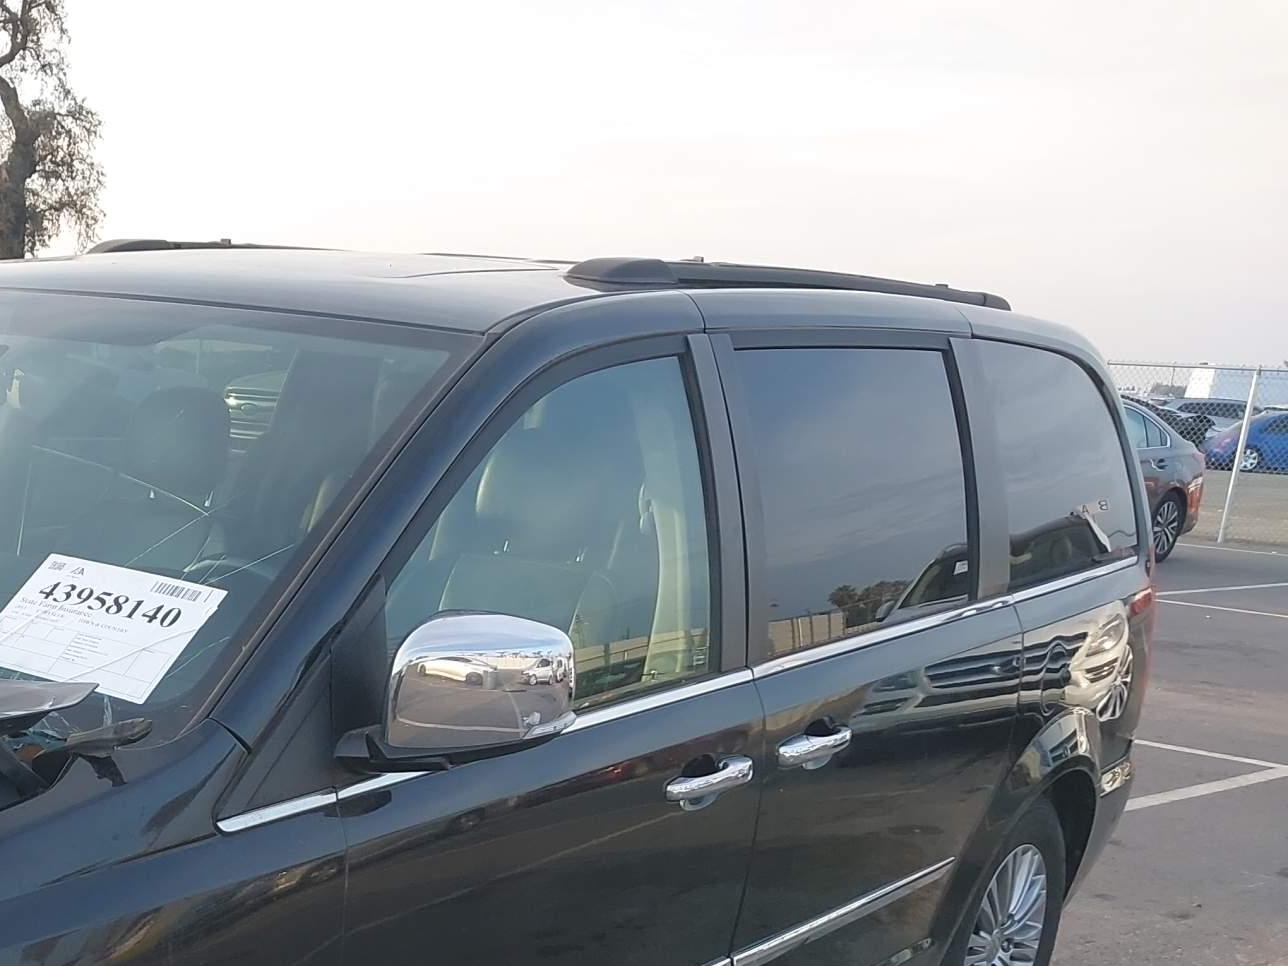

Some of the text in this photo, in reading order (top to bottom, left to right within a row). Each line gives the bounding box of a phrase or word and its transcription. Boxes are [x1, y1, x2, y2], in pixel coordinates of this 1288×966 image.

[20, 597, 37, 606] State
[38, 600, 58, 610] Farm
[58, 603, 93, 618] Insurance
[38, 581, 182, 628] 43958140
